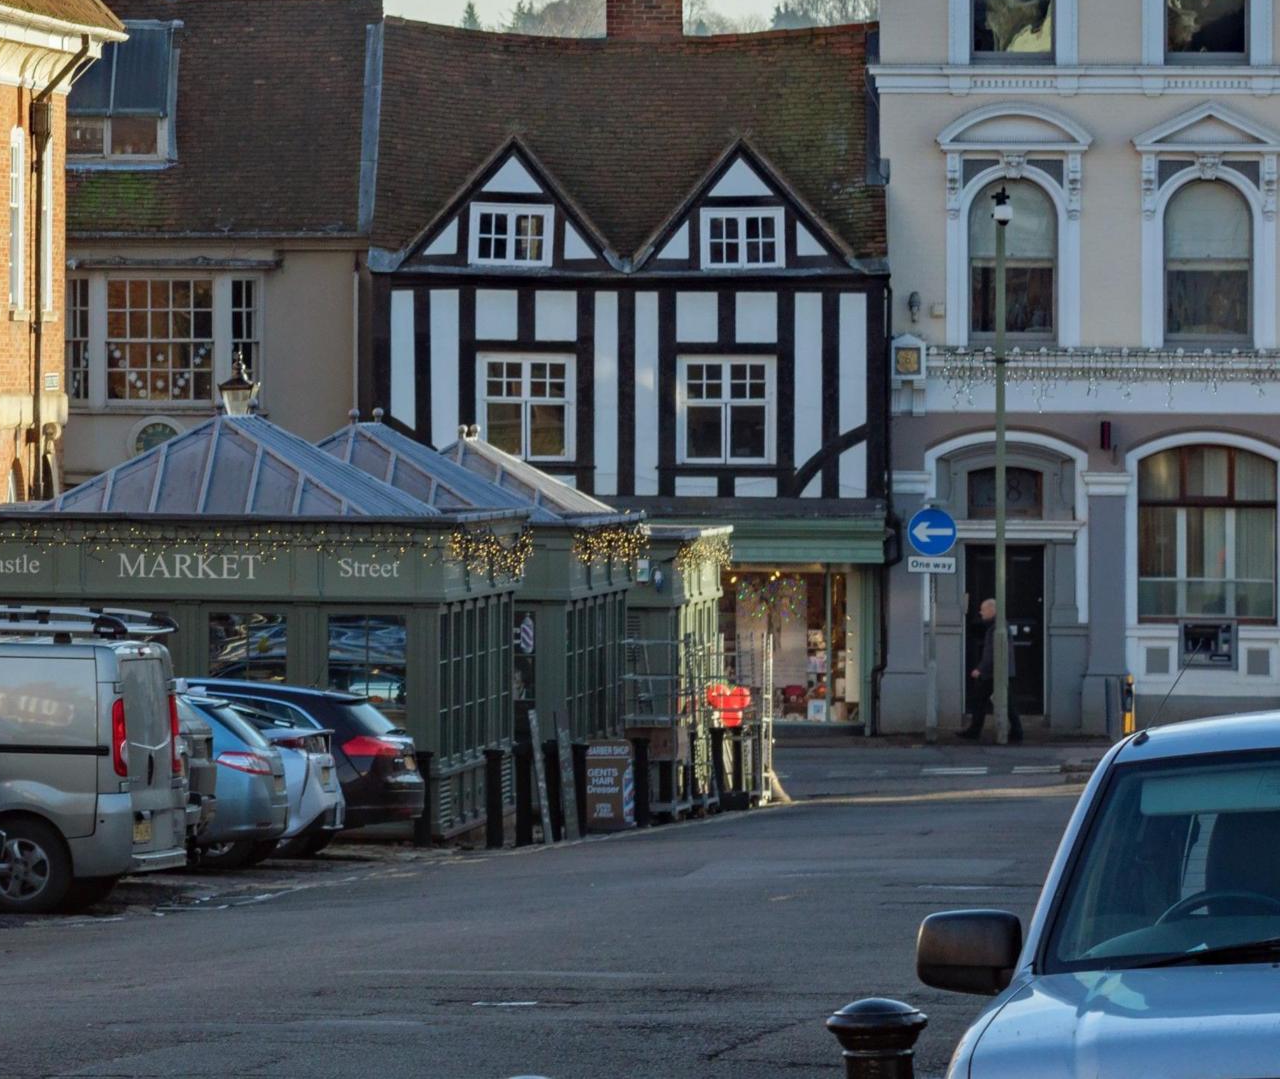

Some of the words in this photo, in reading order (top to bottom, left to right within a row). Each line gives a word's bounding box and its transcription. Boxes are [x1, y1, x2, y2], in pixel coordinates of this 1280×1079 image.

[117, 553, 261, 580] MARKET
[339, 558, 400, 579] Street
[910, 560, 931, 569] One
[932, 561, 953, 571] way
[586, 768, 619, 777] GENTS
[591, 777, 615, 785] HAIR
